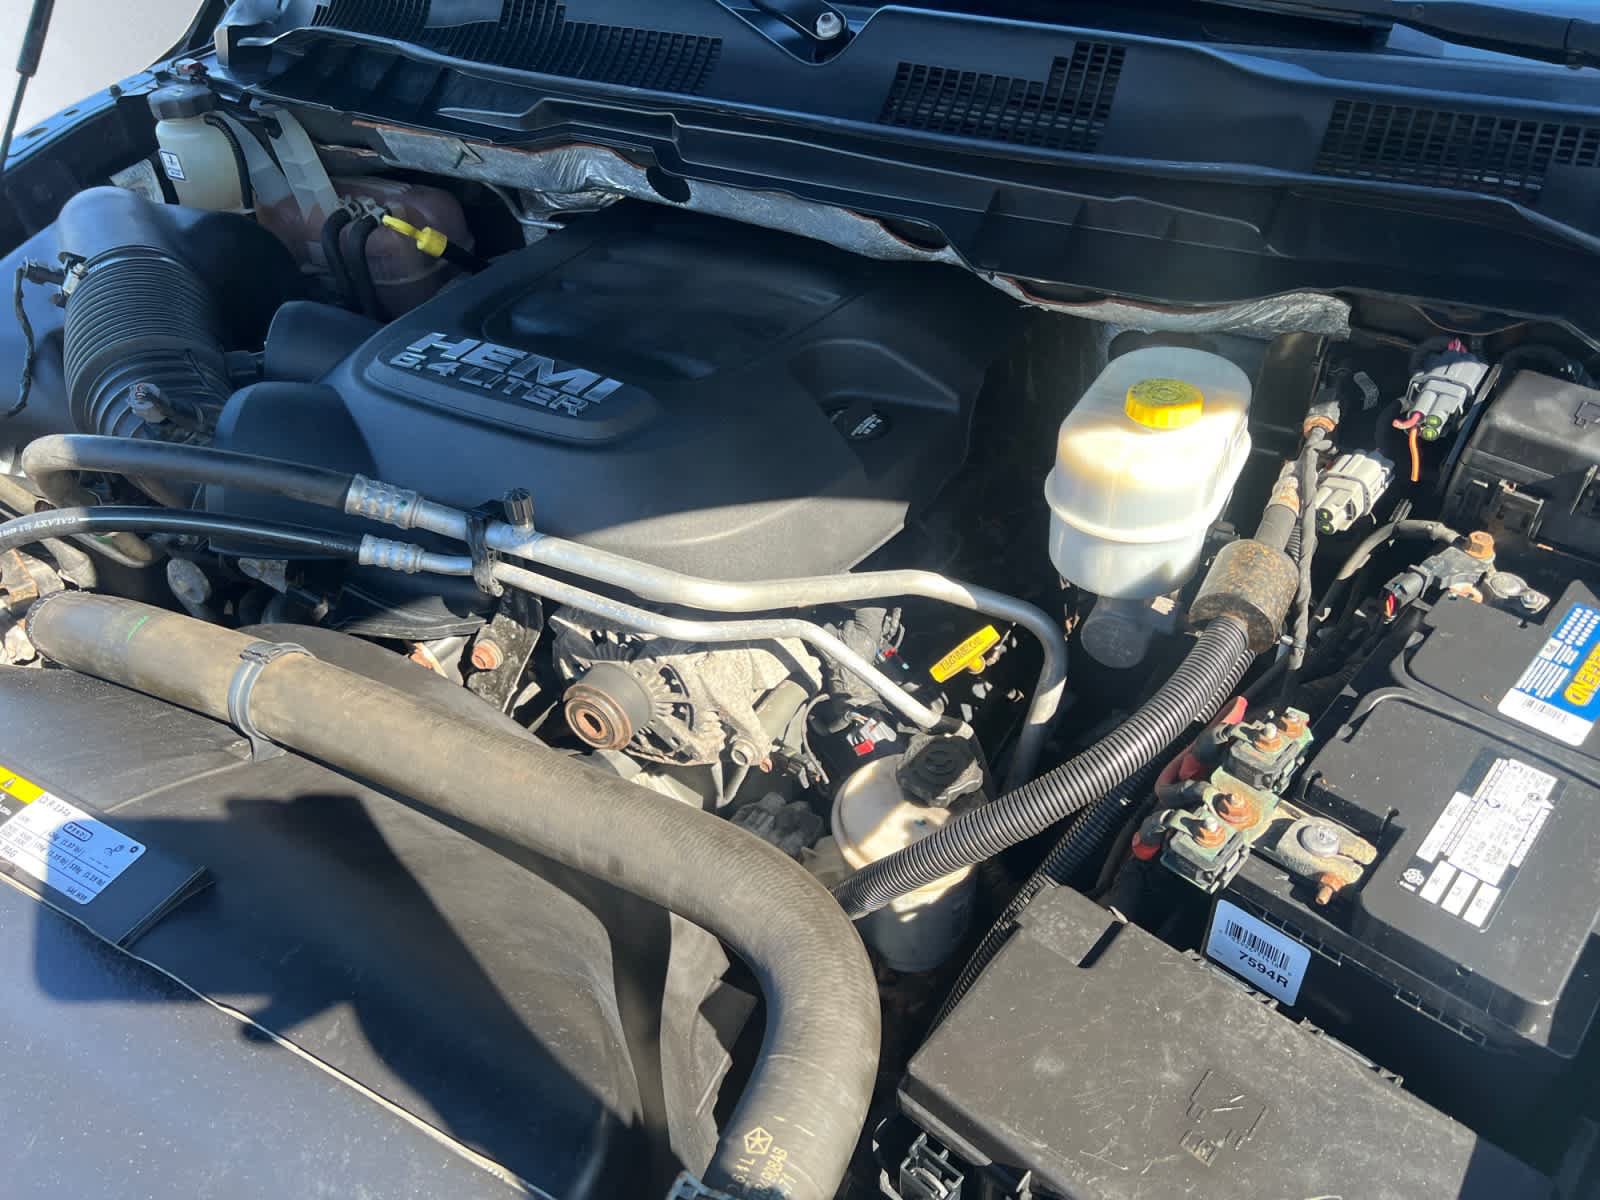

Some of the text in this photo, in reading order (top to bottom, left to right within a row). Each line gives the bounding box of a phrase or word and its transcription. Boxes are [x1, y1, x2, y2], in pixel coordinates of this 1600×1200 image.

[389, 351, 589, 417] 6.4 LITER
[406, 332, 624, 404] HEMI
[33, 516, 76, 529] GALAXY
[1239, 950, 1289, 988] 7594R
